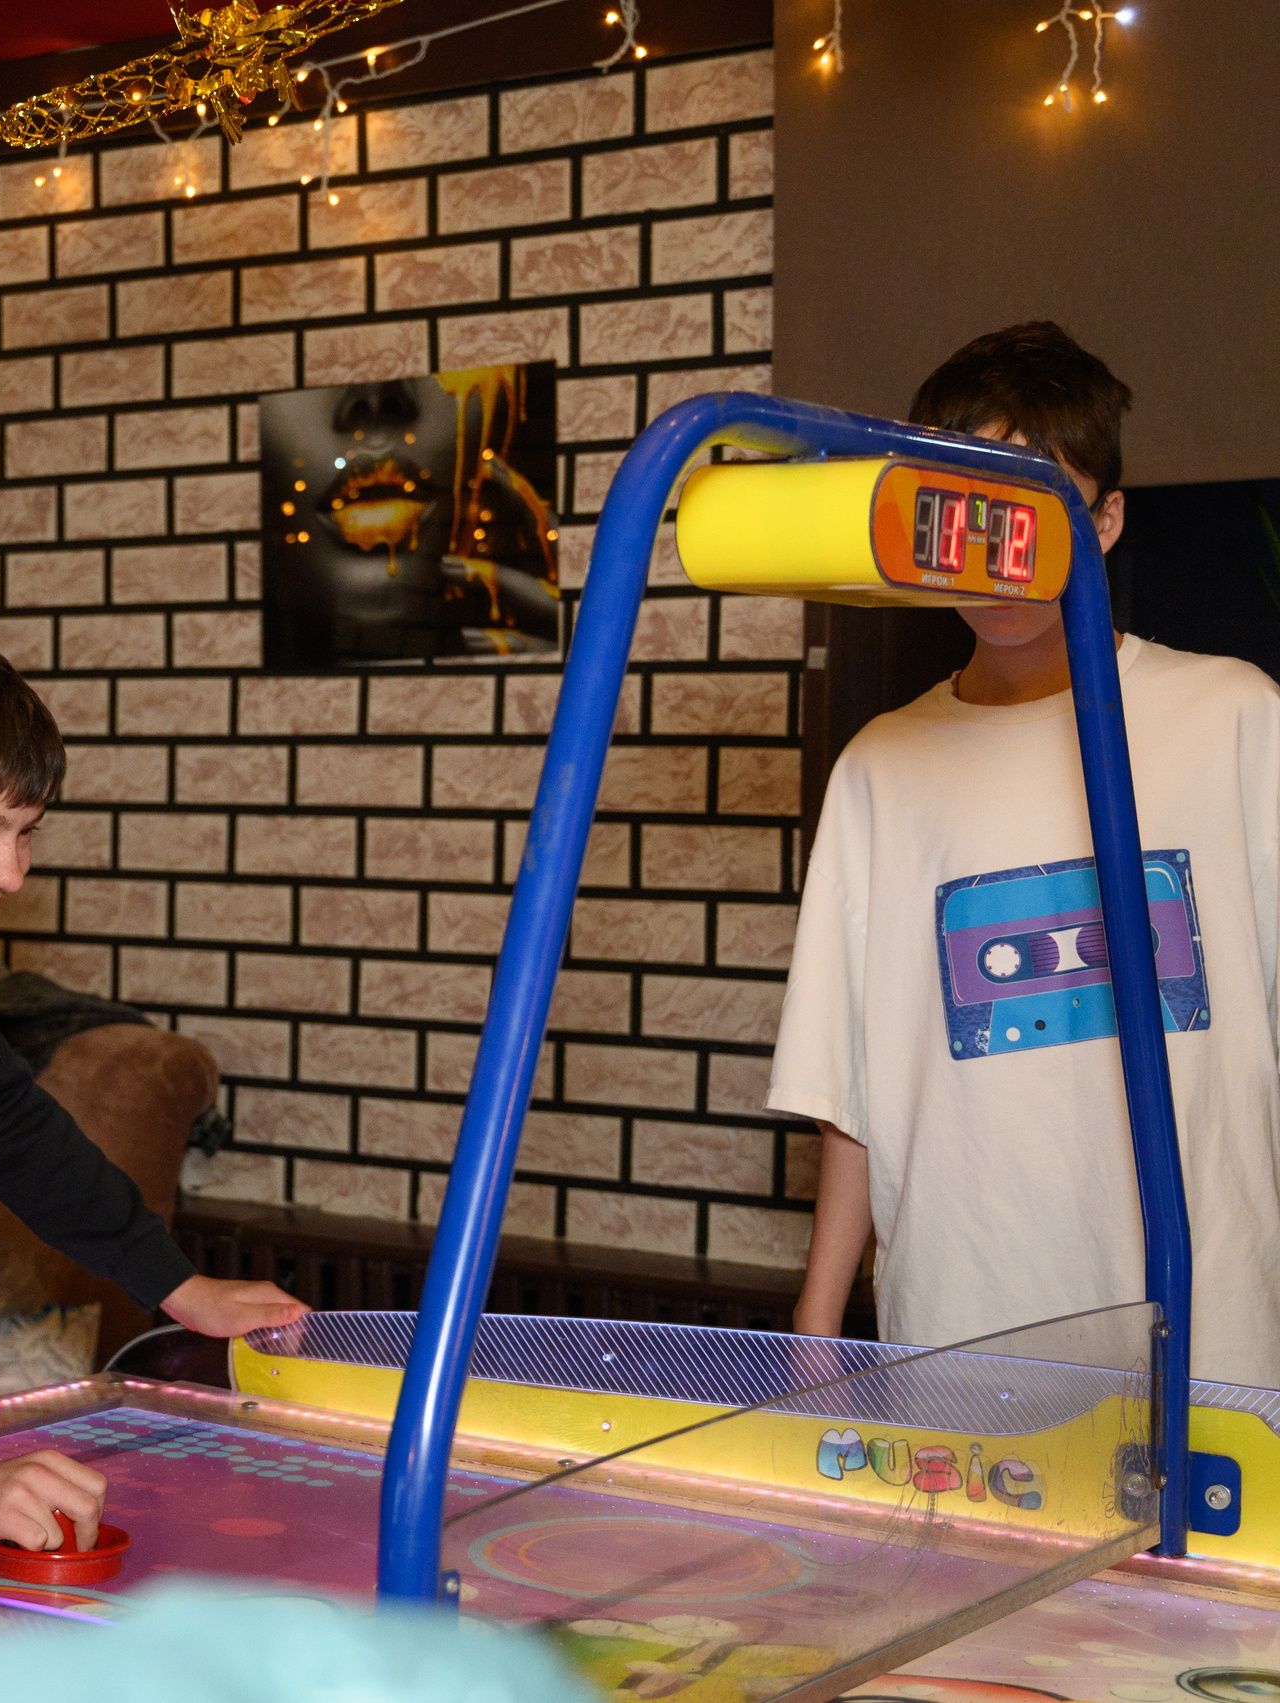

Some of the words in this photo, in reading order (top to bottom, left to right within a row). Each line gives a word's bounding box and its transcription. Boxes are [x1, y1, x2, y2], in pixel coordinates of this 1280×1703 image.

[921, 573, 948, 587] ИГРОК
[951, 576, 956, 587] 1
[993, 582, 1019, 596] ИГРОК
[1020, 585, 1026, 596] 2
